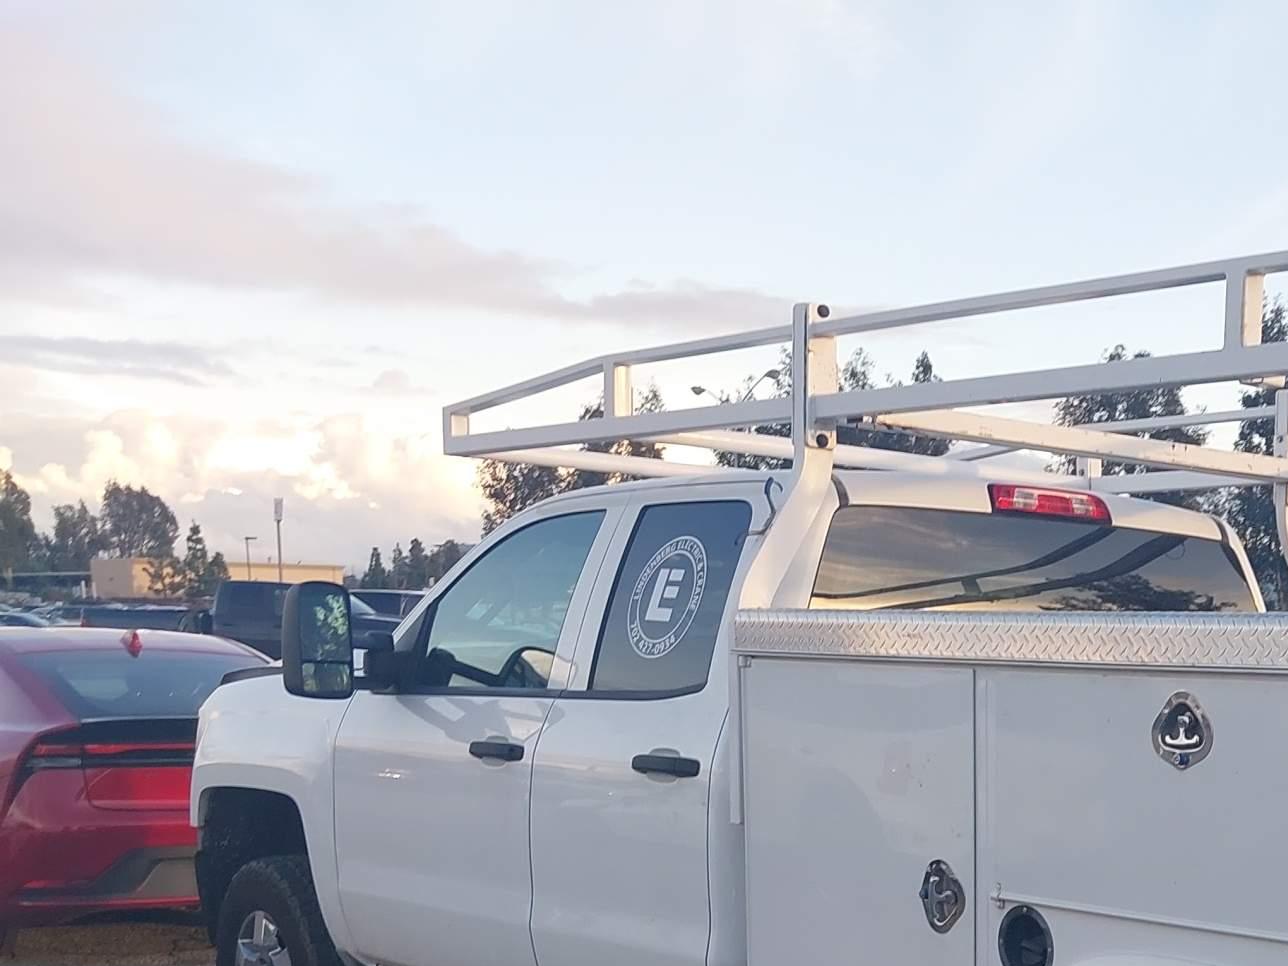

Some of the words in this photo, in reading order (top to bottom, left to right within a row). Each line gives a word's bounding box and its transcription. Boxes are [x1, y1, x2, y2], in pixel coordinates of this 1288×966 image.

[677, 539, 704, 563] ELECTRIC
[645, 568, 686, 622] E
[690, 573, 704, 611] CRANE
[630, 620, 640, 643] 702
[638, 634, 676, 654] 427-0934
